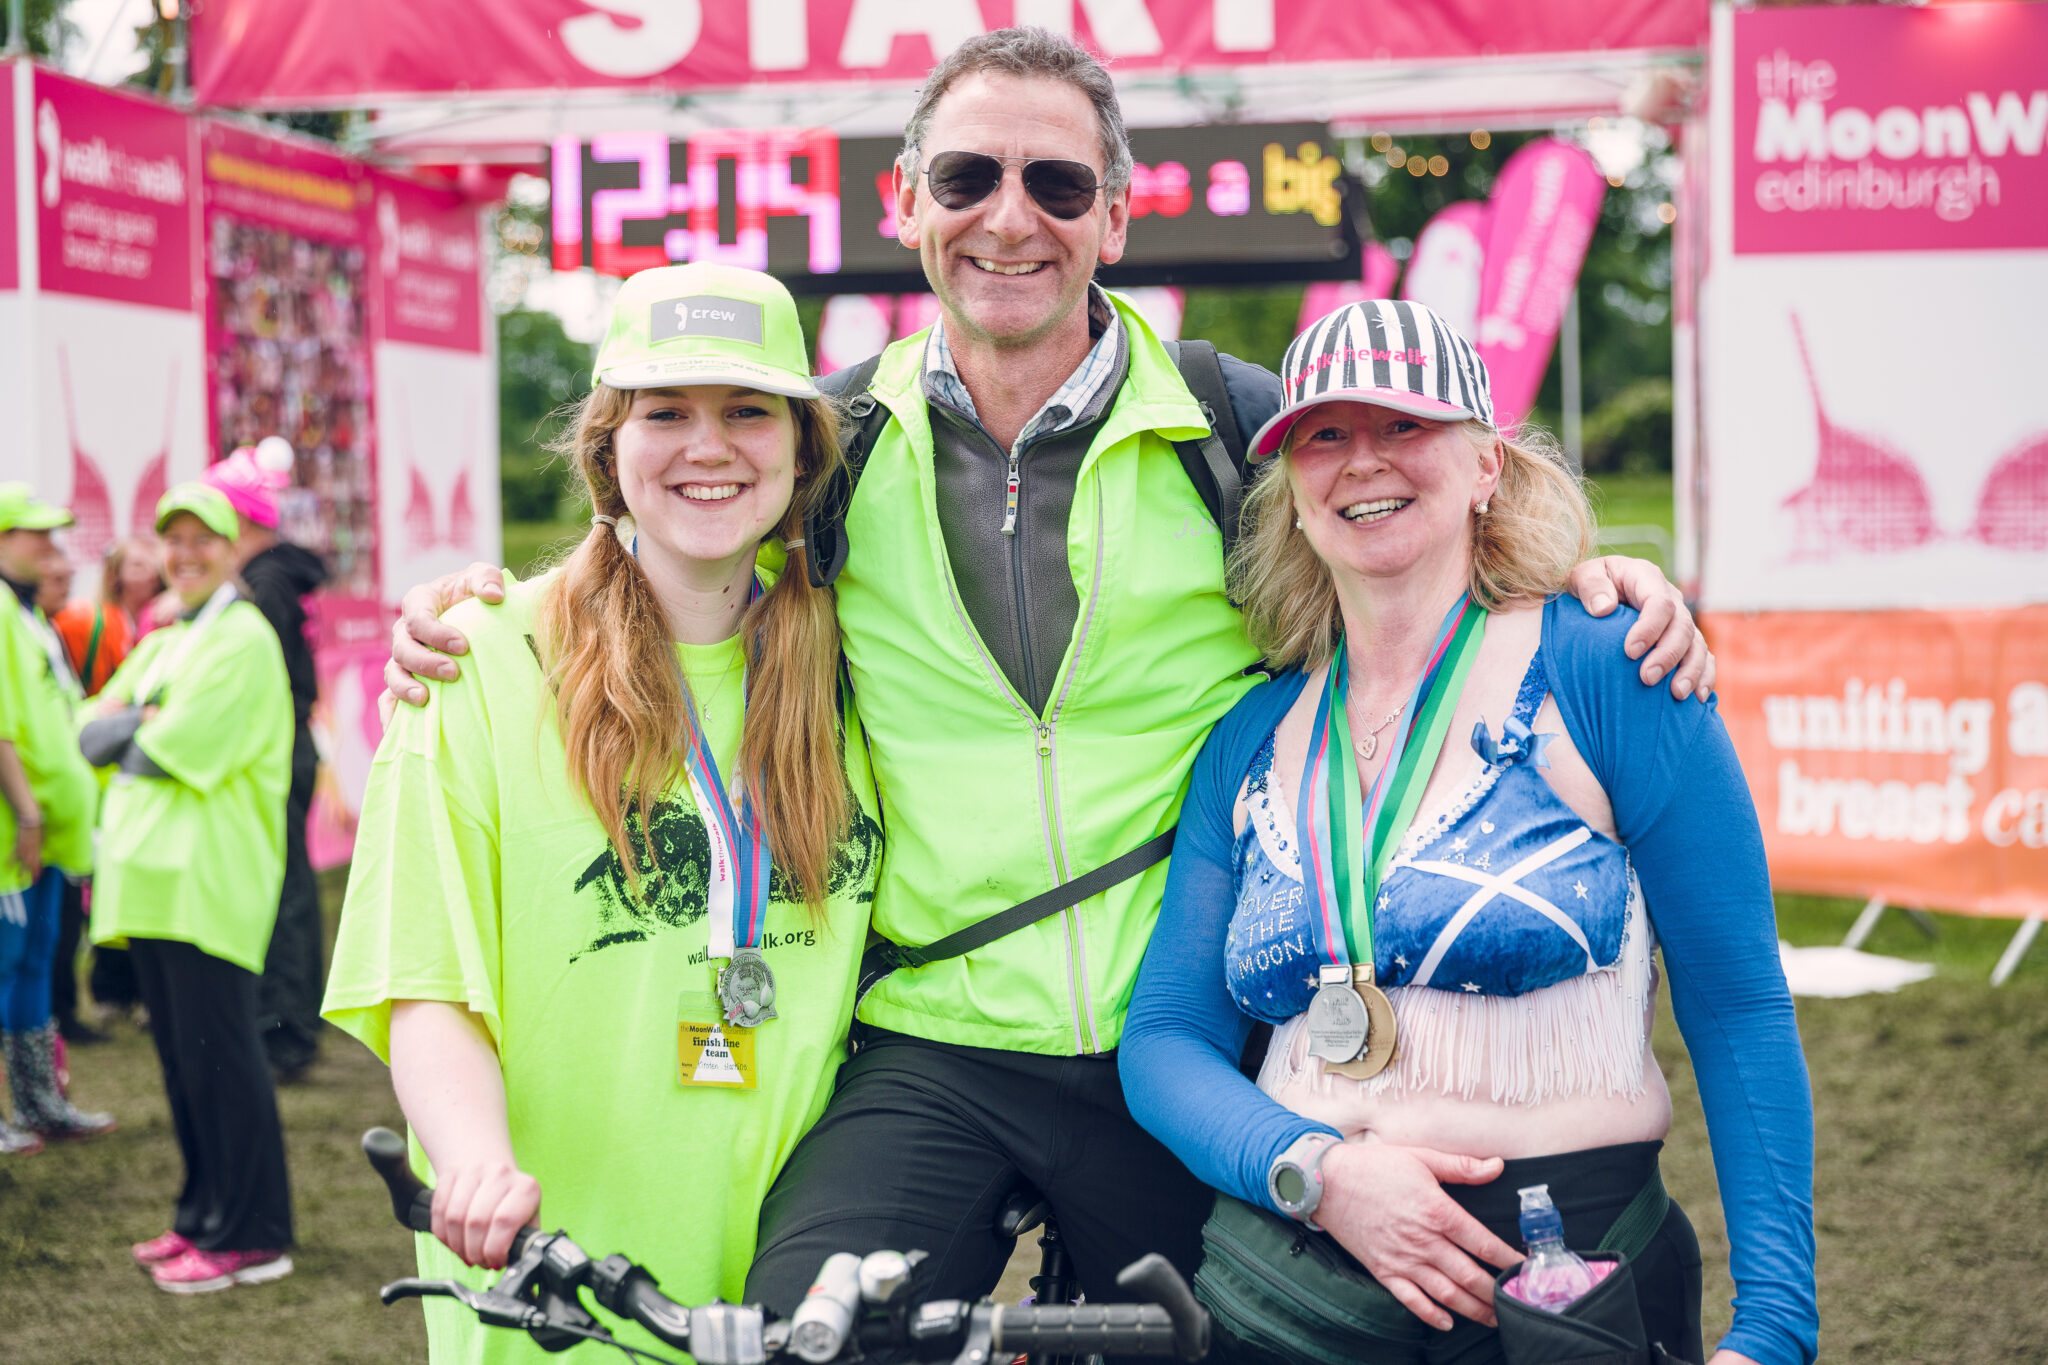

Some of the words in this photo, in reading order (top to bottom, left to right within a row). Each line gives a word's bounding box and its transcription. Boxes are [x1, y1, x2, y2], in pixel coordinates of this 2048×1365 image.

[1755, 47, 1838, 101] the
[551, 128, 841, 277] 12:09
[1755, 153, 2000, 222] edinburgh
[691, 307, 736, 323] crew
[1294, 345, 1428, 389] walkthewalk
[1762, 677, 1995, 775] uniting
[1776, 758, 1975, 845] breast
[1242, 886, 1304, 917] OVER
[1245, 909, 1295, 948] THE
[1238, 934, 1305, 980] MOON
[692, 1036, 720, 1047] finish
[723, 1038, 740, 1048] line
[705, 1048, 729, 1058] team
